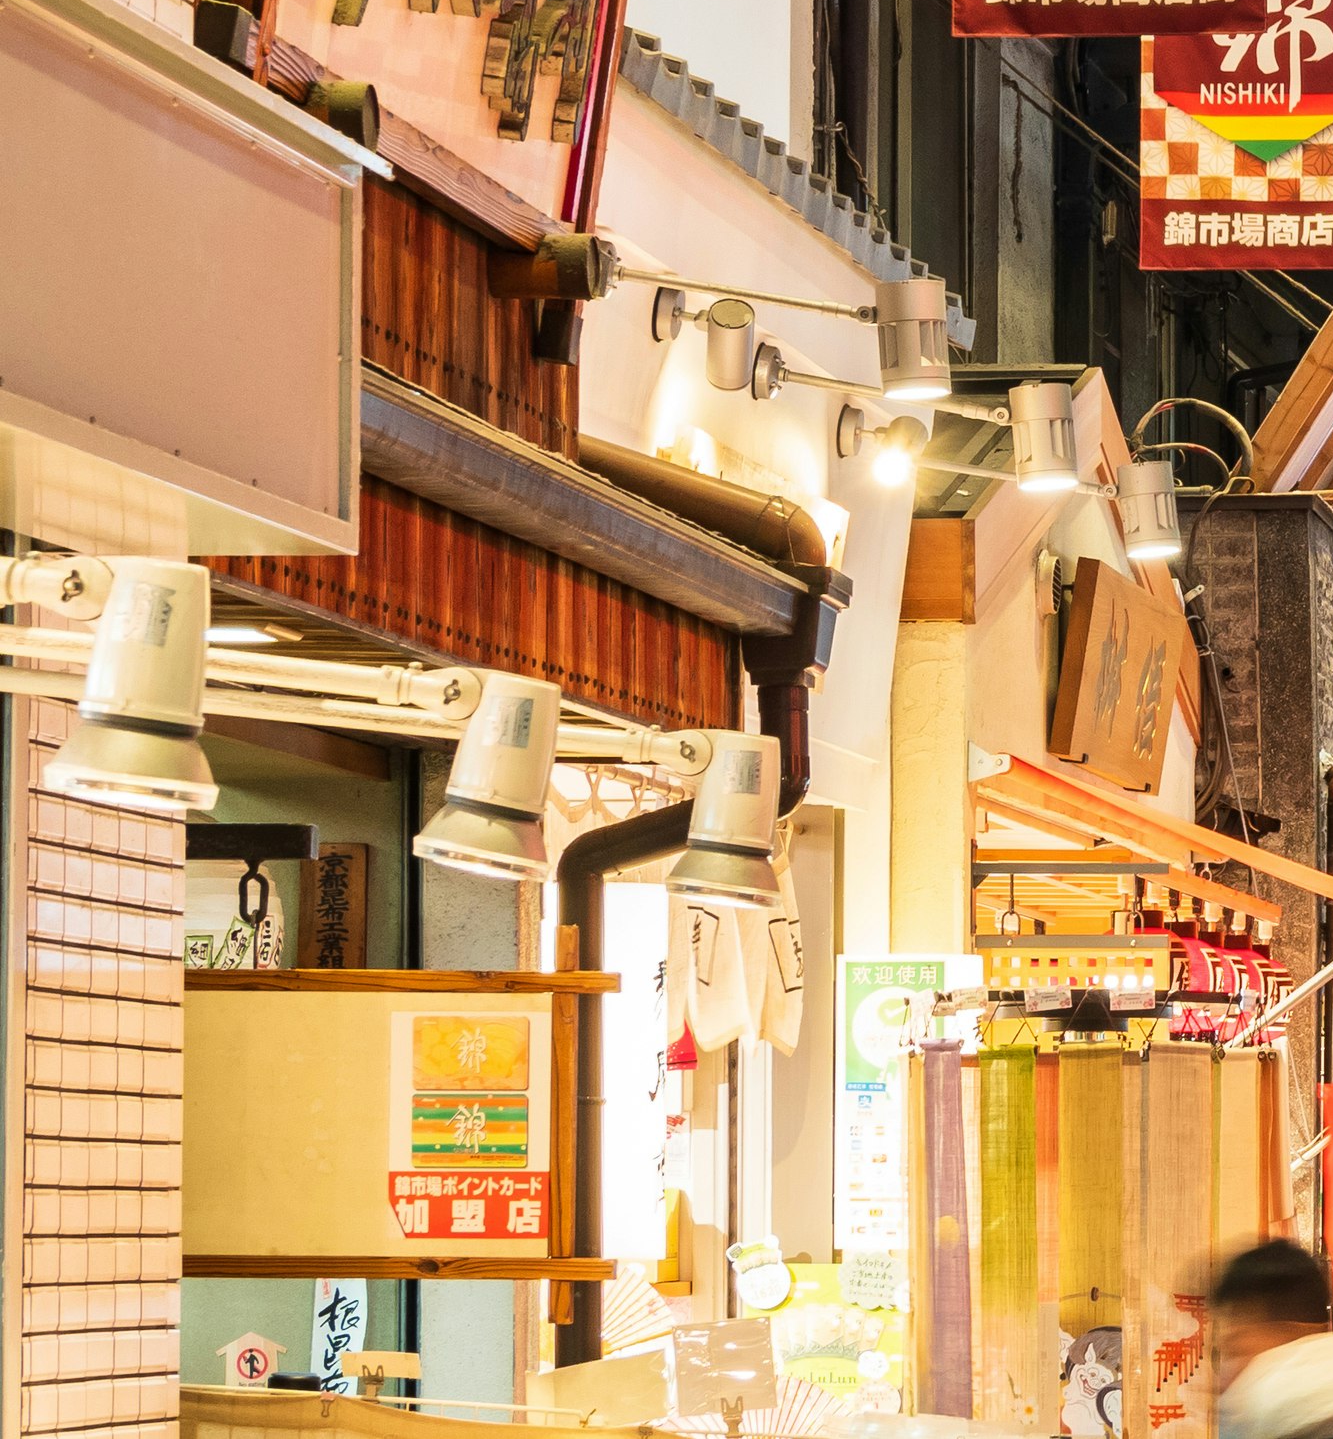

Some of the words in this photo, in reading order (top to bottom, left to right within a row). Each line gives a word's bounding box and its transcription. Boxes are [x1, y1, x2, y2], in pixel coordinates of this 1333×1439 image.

[1199, 83, 1286, 106] NISHIKI
[316, 851, 352, 969] 京都昆布工業組
[851, 965, 938, 986] 欢迎使用
[451, 1027, 488, 1074] 錦
[445, 1103, 487, 1154] 錦
[394, 1175, 543, 1197] 錦市場ポイントカード
[396, 1198, 542, 1234] 加盟店
